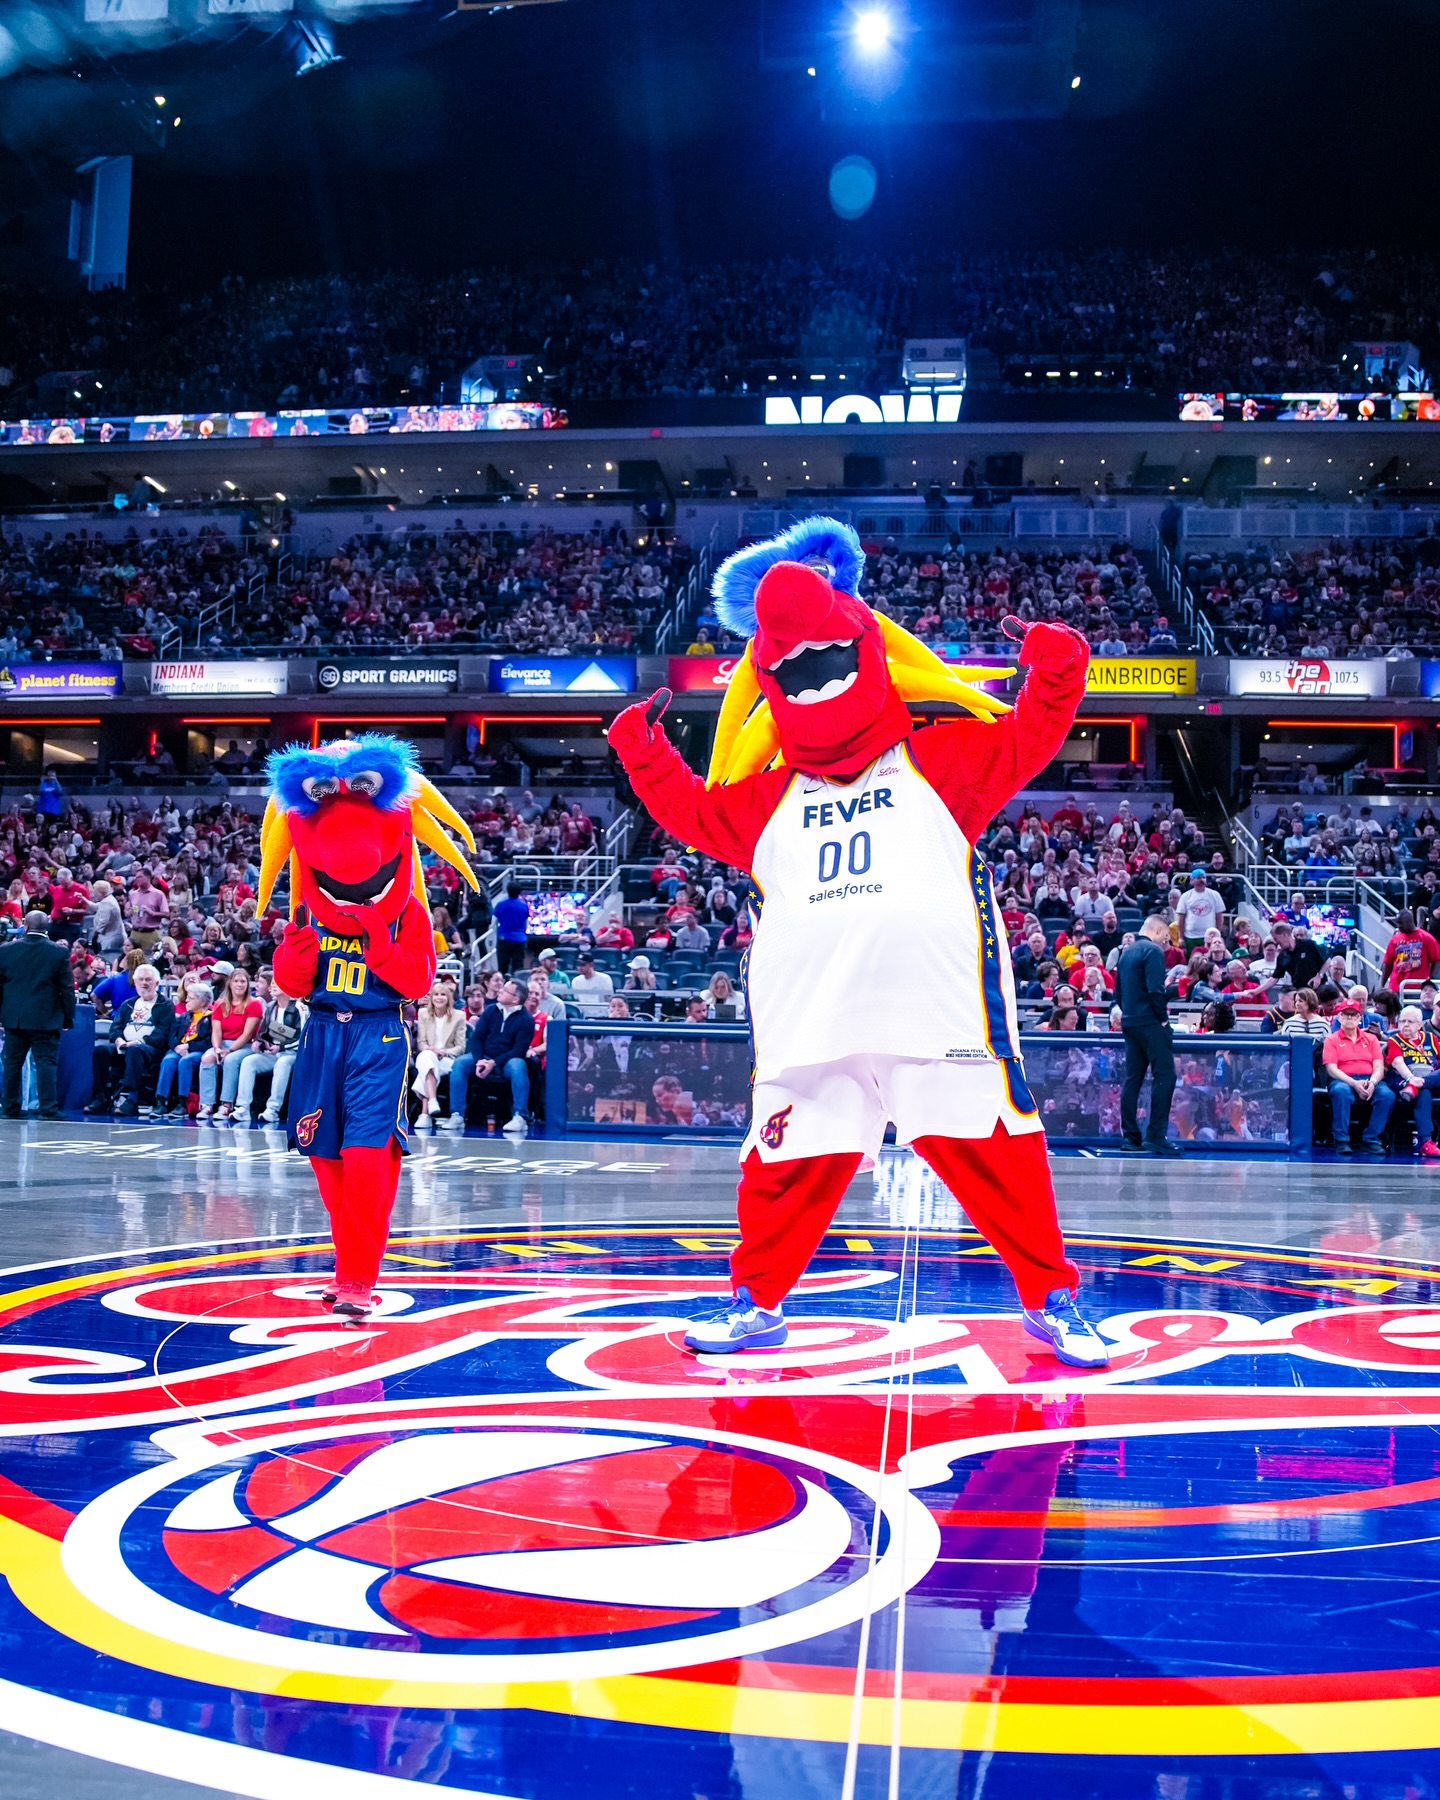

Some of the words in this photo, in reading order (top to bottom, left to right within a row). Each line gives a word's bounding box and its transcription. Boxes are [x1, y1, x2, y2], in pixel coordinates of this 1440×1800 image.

[154, 664, 204, 680] INDIANA
[322, 671, 336, 682] SG
[342, 669, 386, 683] SPORT
[389, 669, 457, 683] GRAPHICS
[501, 667, 552, 679] Elevance
[1086, 667, 1188, 686] AINBRIDGE
[1259, 670, 1281, 683] 93.5
[1284, 660, 1321, 678] the
[1335, 671, 1359, 684] 107.5
[20, 674, 65, 691] planet
[68, 673, 116, 687] fitness
[152, 682, 188, 693] Members
[190, 682, 214, 692] Credit
[216, 682, 240, 692] Union
[524, 678, 552, 686] Health
[802, 787, 896, 829] FEVER
[1254, 806, 1260, 820] 6
[818, 831, 871, 883] 00
[808, 882, 883, 904] salesforce
[326, 957, 366, 995] 00
[22, 1140, 670, 1173] GAINBIDGE
